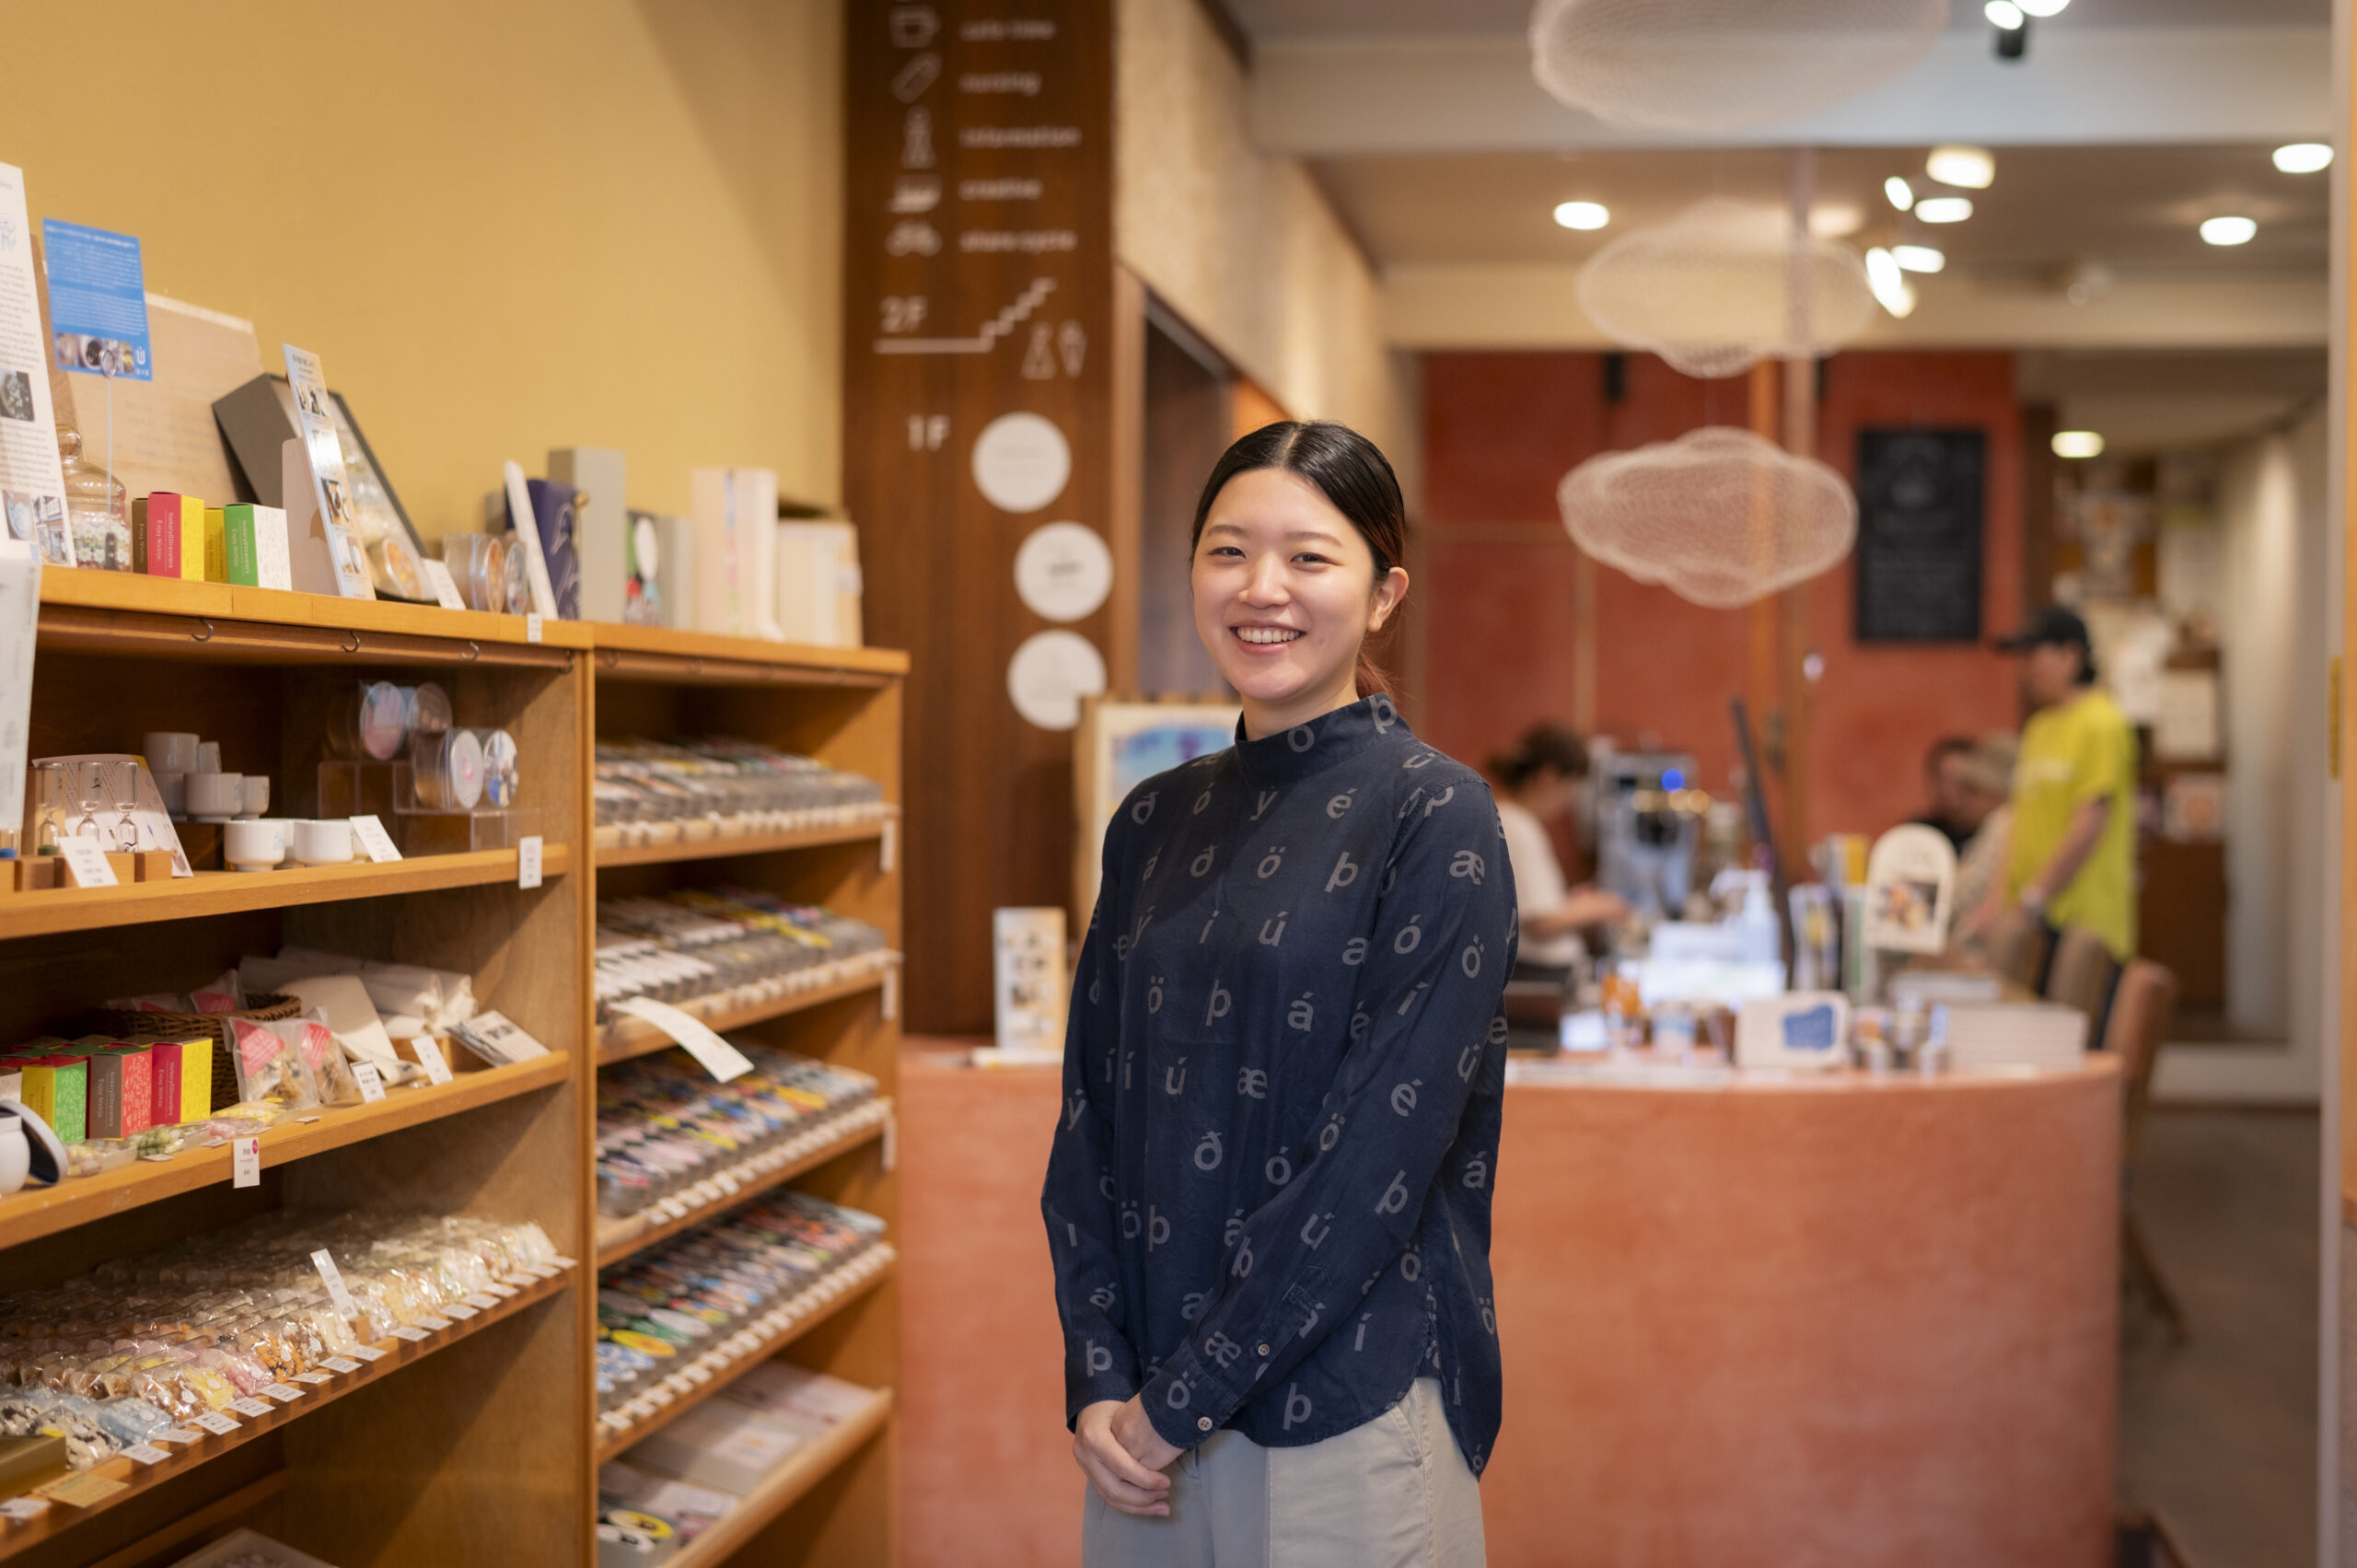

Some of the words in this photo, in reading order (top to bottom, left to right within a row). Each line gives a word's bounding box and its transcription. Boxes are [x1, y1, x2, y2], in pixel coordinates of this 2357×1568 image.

[958, 125, 1081, 149] information
[880, 296, 927, 333] 2F
[907, 413, 951, 452] 1F
[1326, 787, 1358, 819] é
[1257, 846, 1286, 878] ö
[1258, 911, 1289, 947] ú
[1394, 913, 1422, 955] ó
[1148, 975, 1165, 1015] ö
[1287, 991, 1315, 1032] á
[1165, 1056, 1187, 1095] ú
[1237, 1066, 1268, 1099] æ
[1390, 1077, 1423, 1117] é
[1319, 1112, 1346, 1151] ö
[1265, 1145, 1292, 1185] ó
[1462, 1151, 1487, 1189] á
[1120, 1200, 1142, 1238] ö
[1354, 1312, 1373, 1352] í
[1479, 1296, 1496, 1335] ö
[1167, 1370, 1197, 1410] ö
